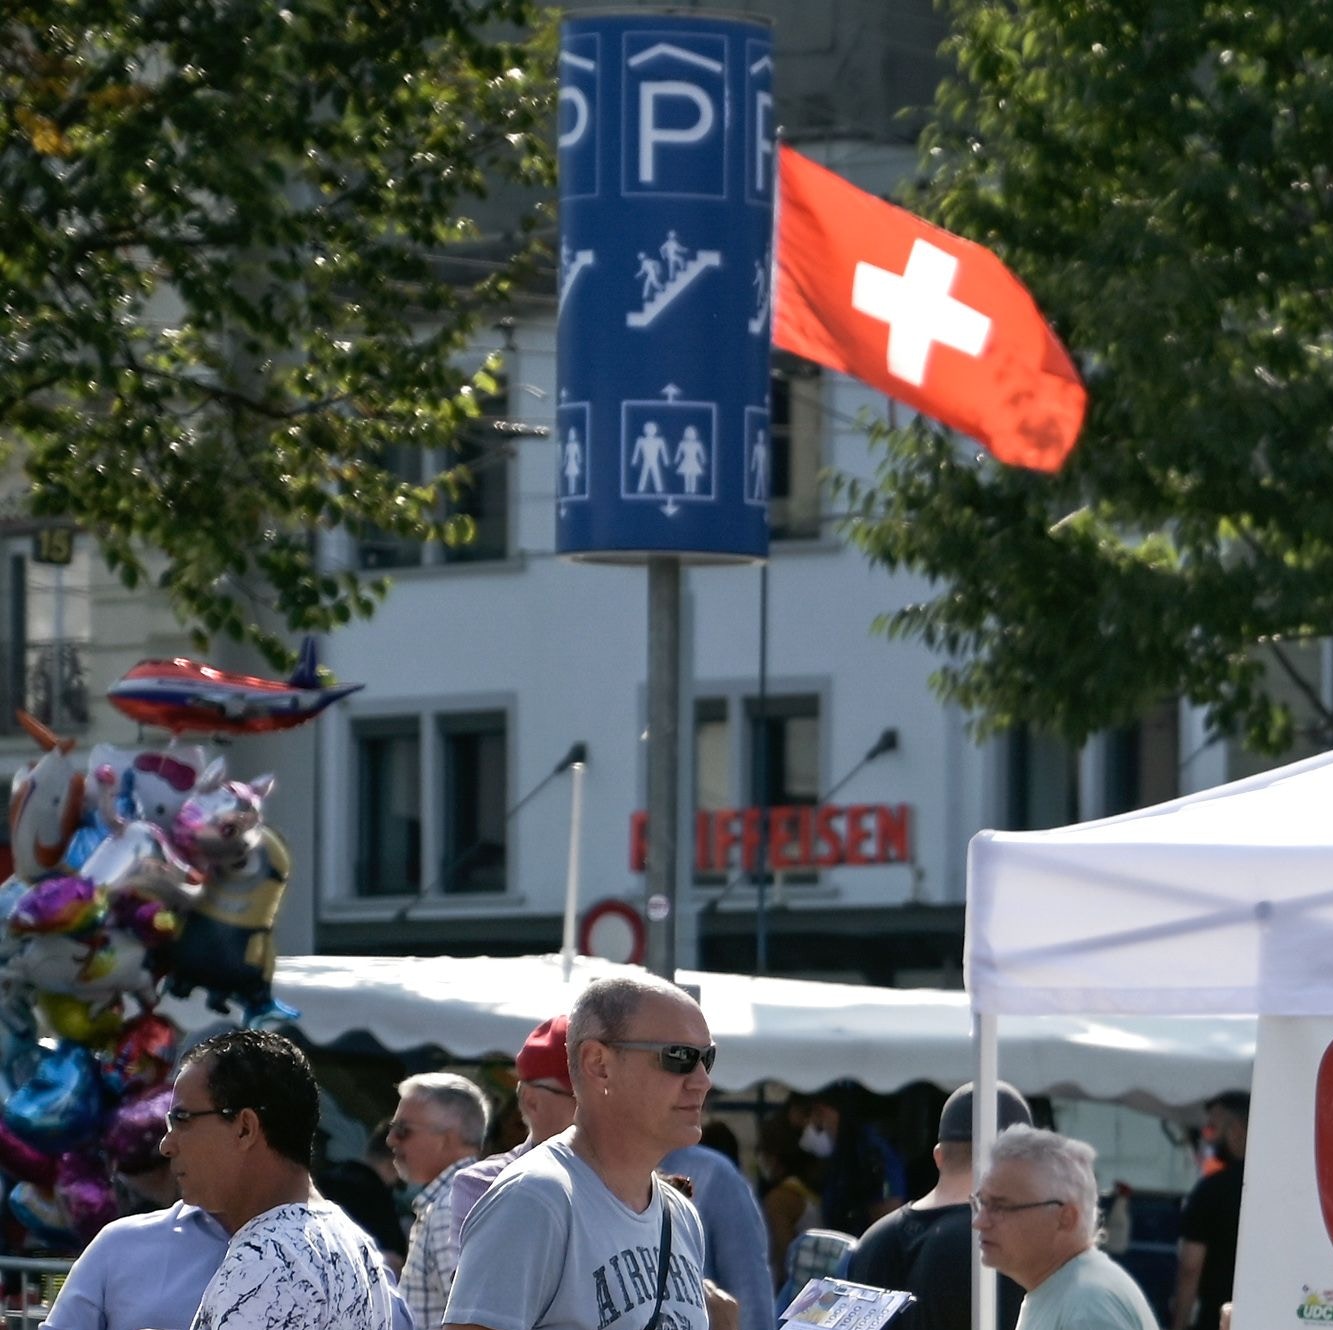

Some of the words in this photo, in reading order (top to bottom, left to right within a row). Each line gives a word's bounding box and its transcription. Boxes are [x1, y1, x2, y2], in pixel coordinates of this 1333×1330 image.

[638, 80, 714, 183] P
[630, 802, 911, 873] RIFFEISEN
[1303, 1305, 1333, 1320] UDC
